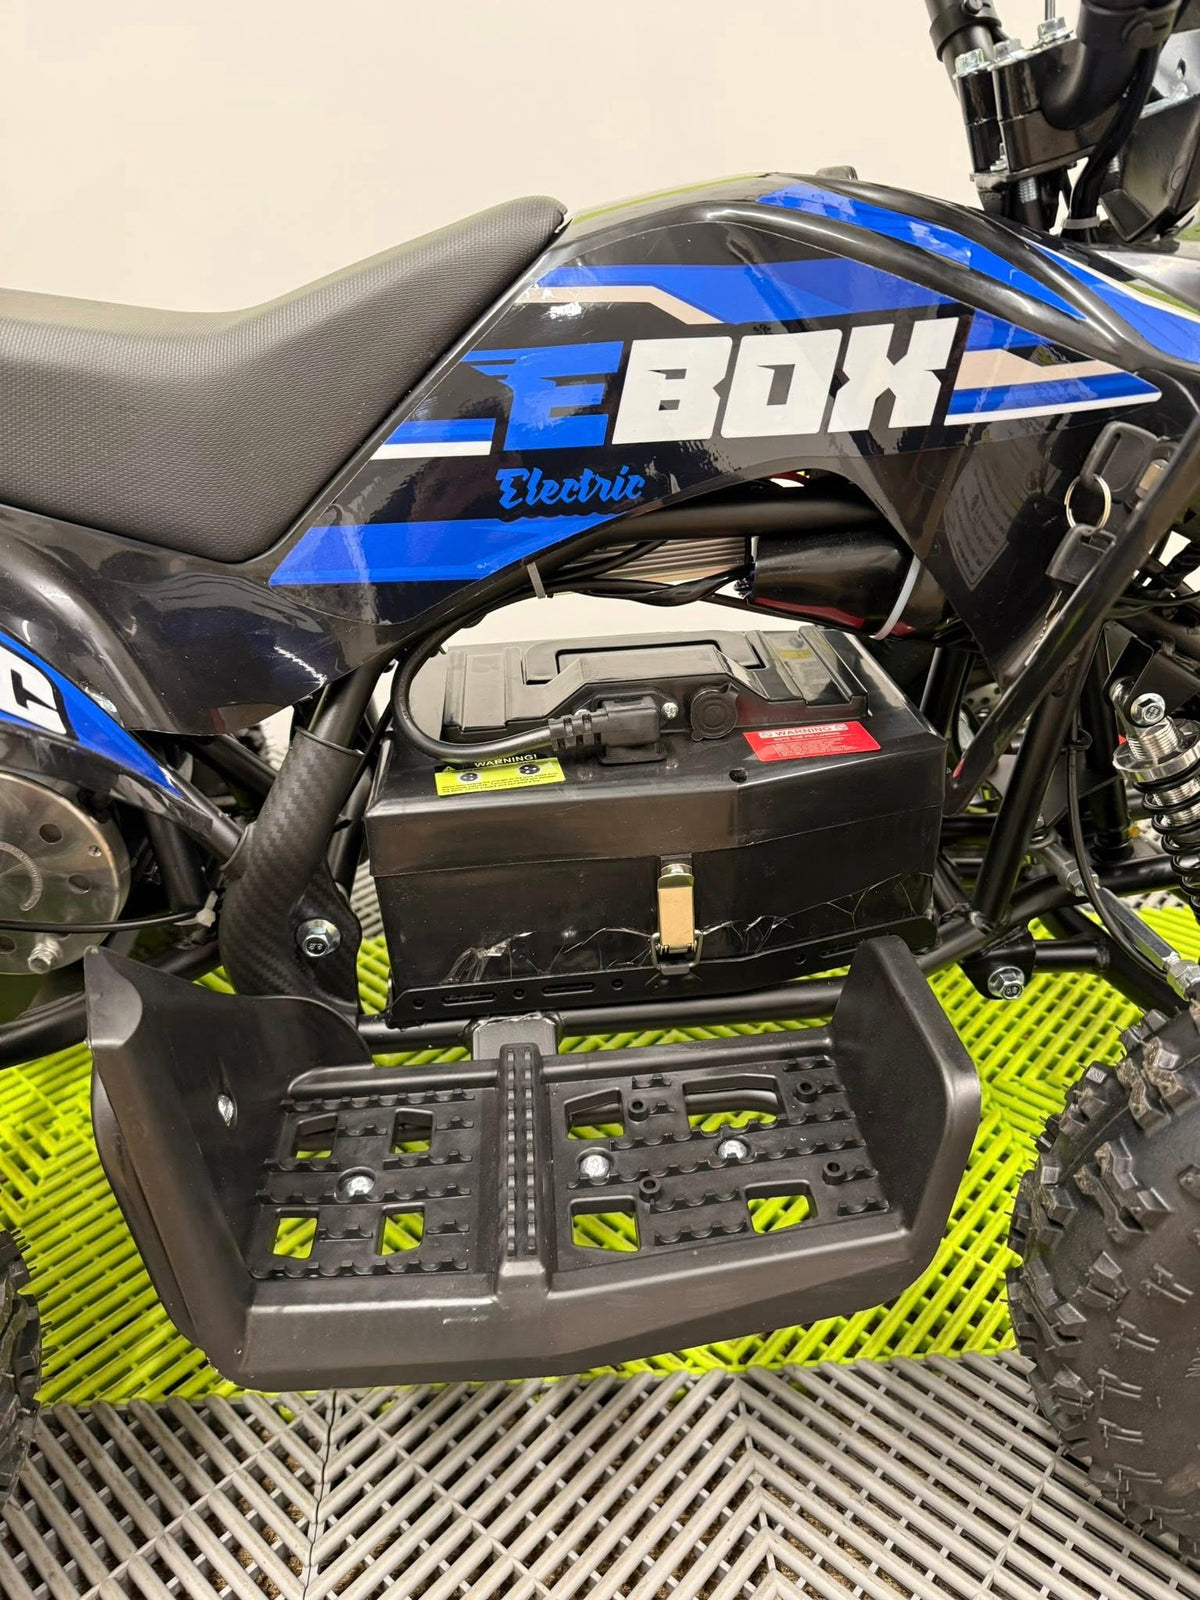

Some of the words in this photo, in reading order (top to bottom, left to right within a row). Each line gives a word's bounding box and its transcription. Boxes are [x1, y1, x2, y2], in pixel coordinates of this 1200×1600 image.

[460, 317, 959, 451] EBOX
[495, 465, 645, 509] Electric
[774, 726, 832, 736] WARNING
[474, 754, 537, 768] WARNING!
